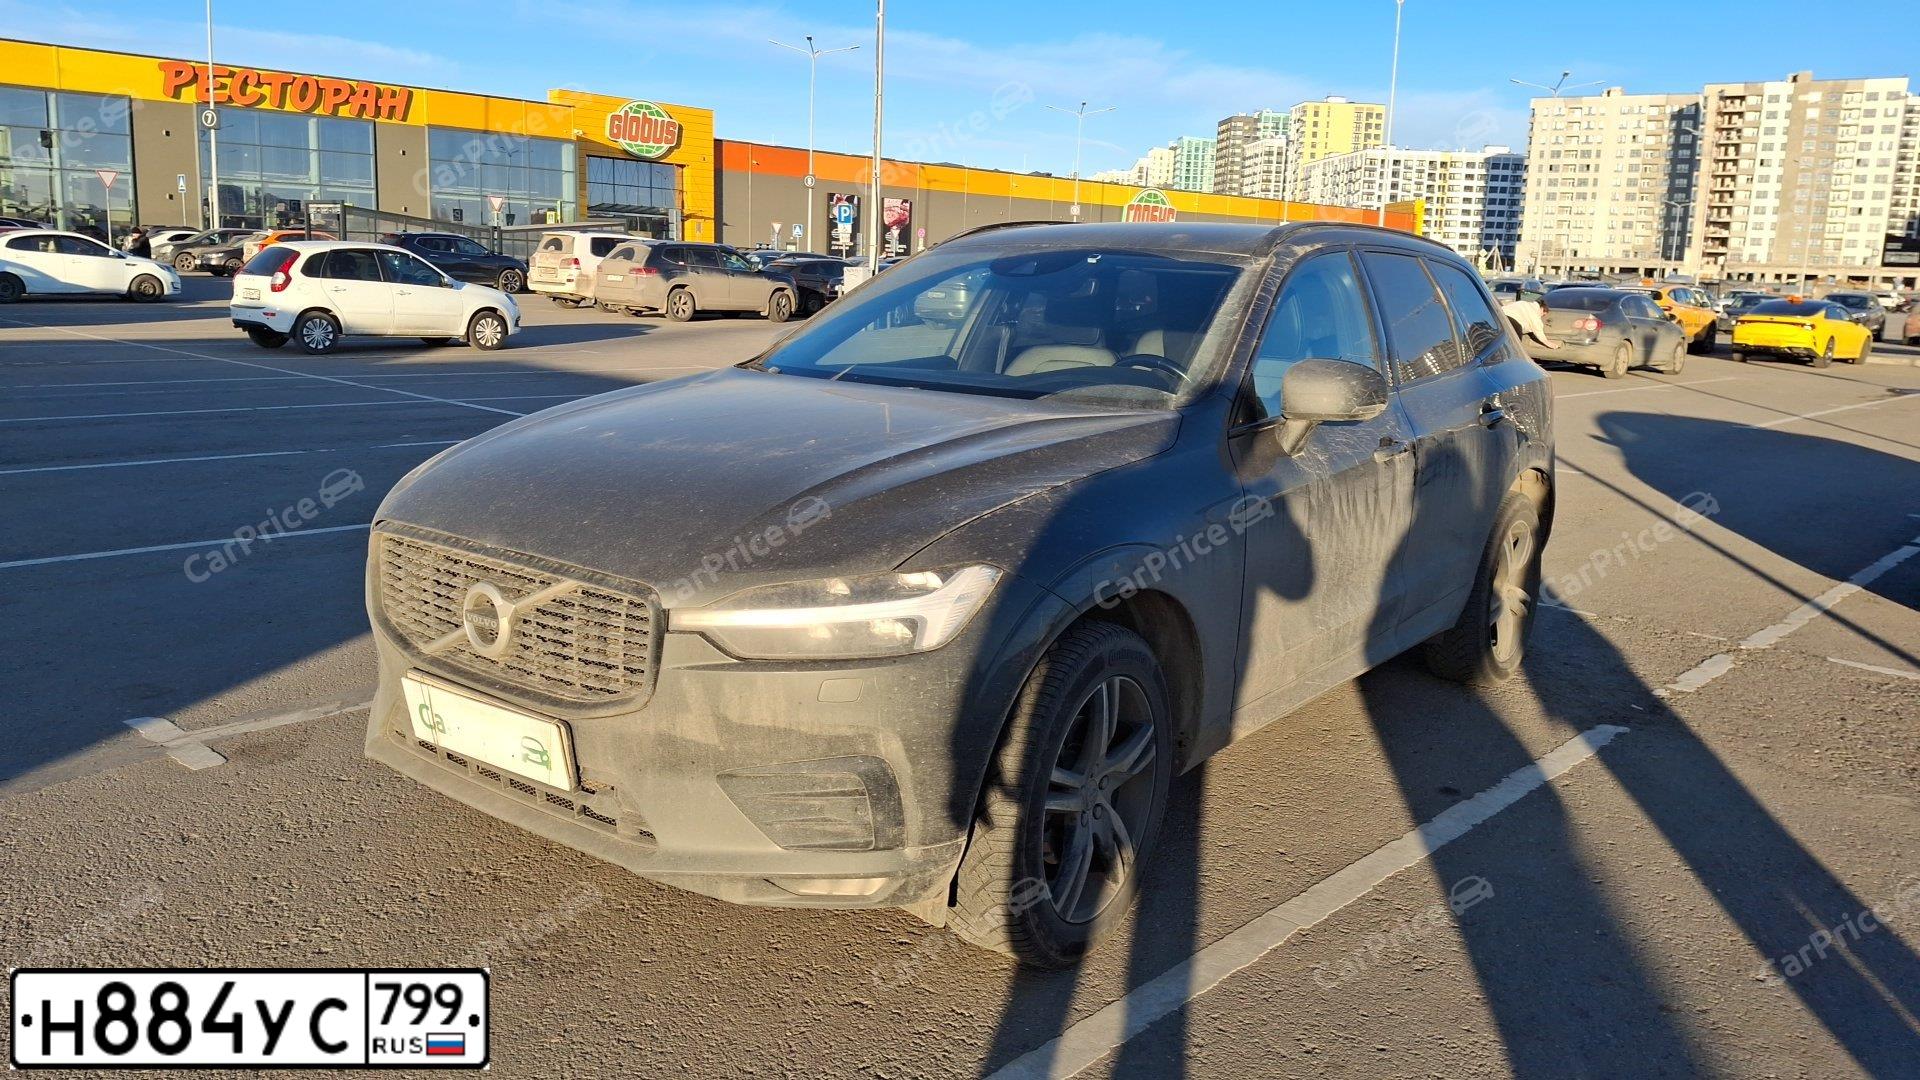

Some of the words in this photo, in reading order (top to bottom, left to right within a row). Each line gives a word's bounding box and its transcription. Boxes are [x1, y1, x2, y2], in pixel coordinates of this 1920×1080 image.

[158, 61, 411, 121] РЕСТОРАН
[607, 108, 679, 146] Globus
[840, 206, 850, 222] P
[466, 612, 498, 628] VOLVO
